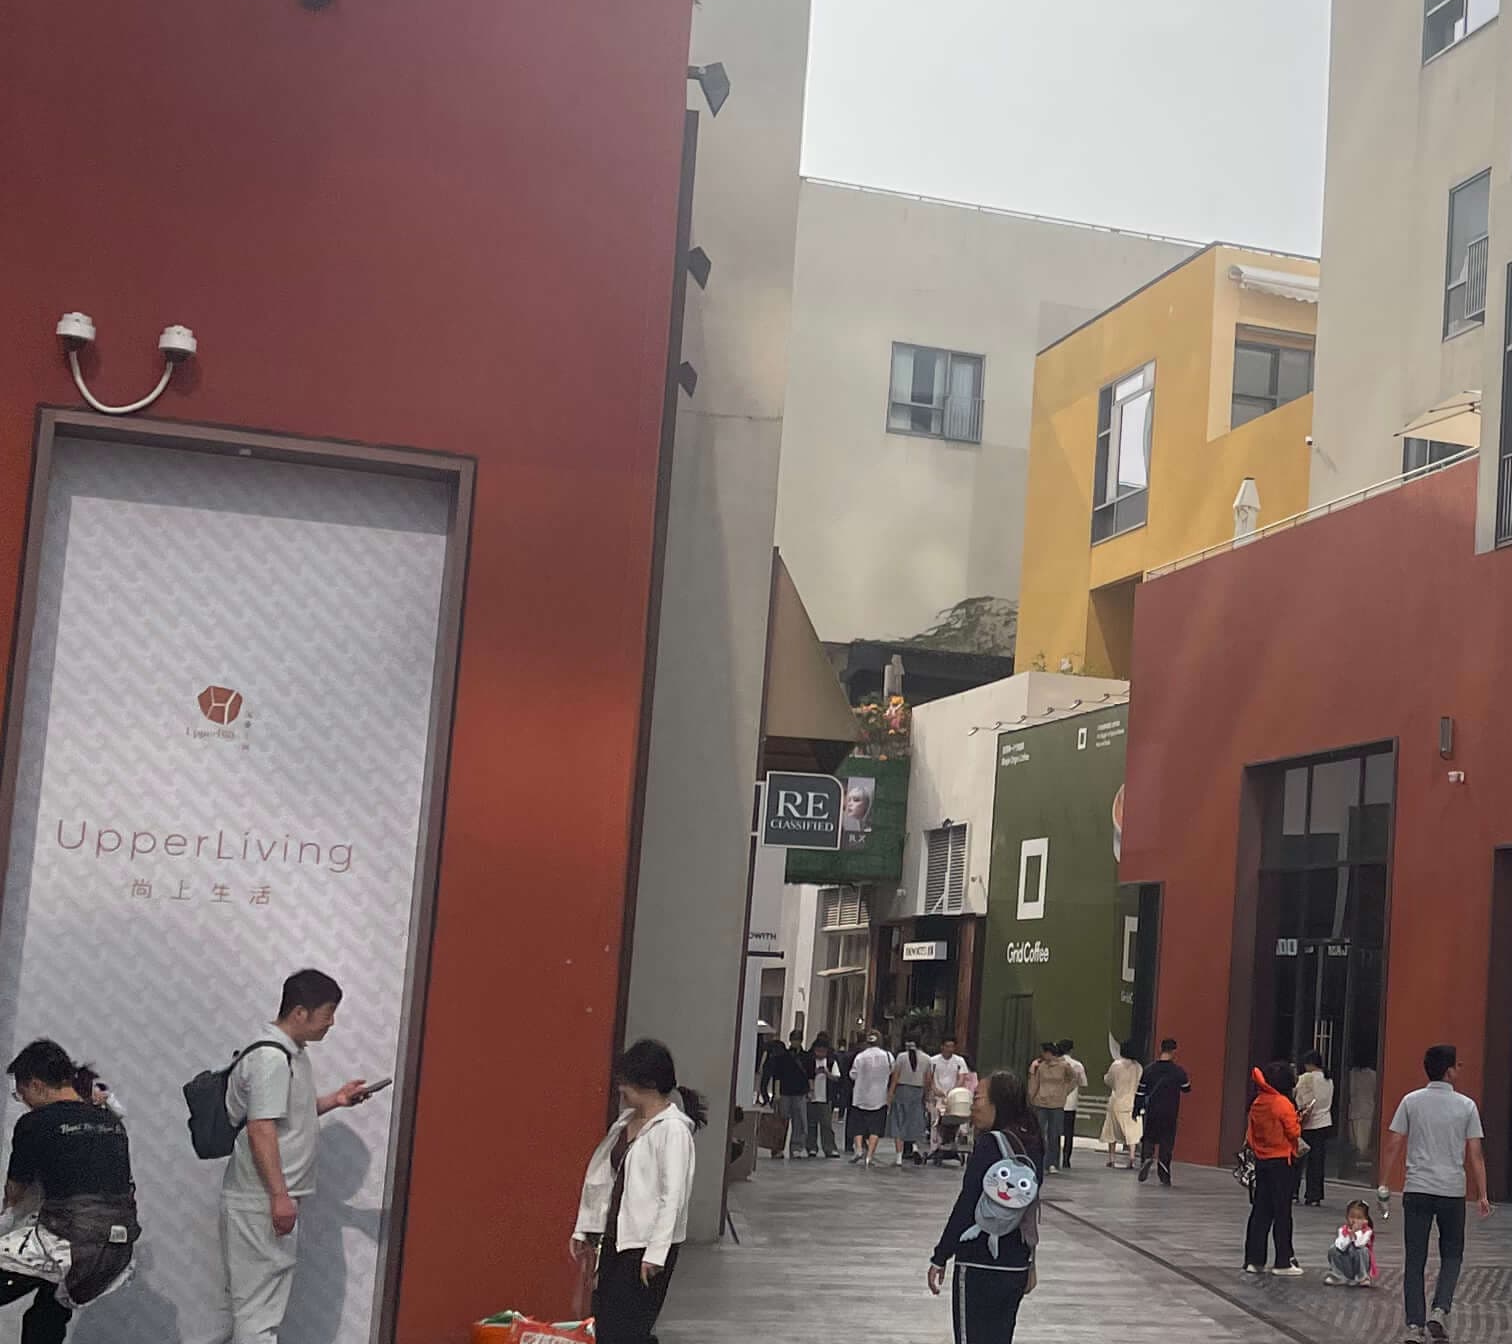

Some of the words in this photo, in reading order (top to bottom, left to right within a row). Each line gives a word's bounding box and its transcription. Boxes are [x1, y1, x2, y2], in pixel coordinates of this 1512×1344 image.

[777, 790, 829, 819] RE
[770, 819, 834, 832] CLASSIFIED
[130, 878, 272, 905] 尚上生活
